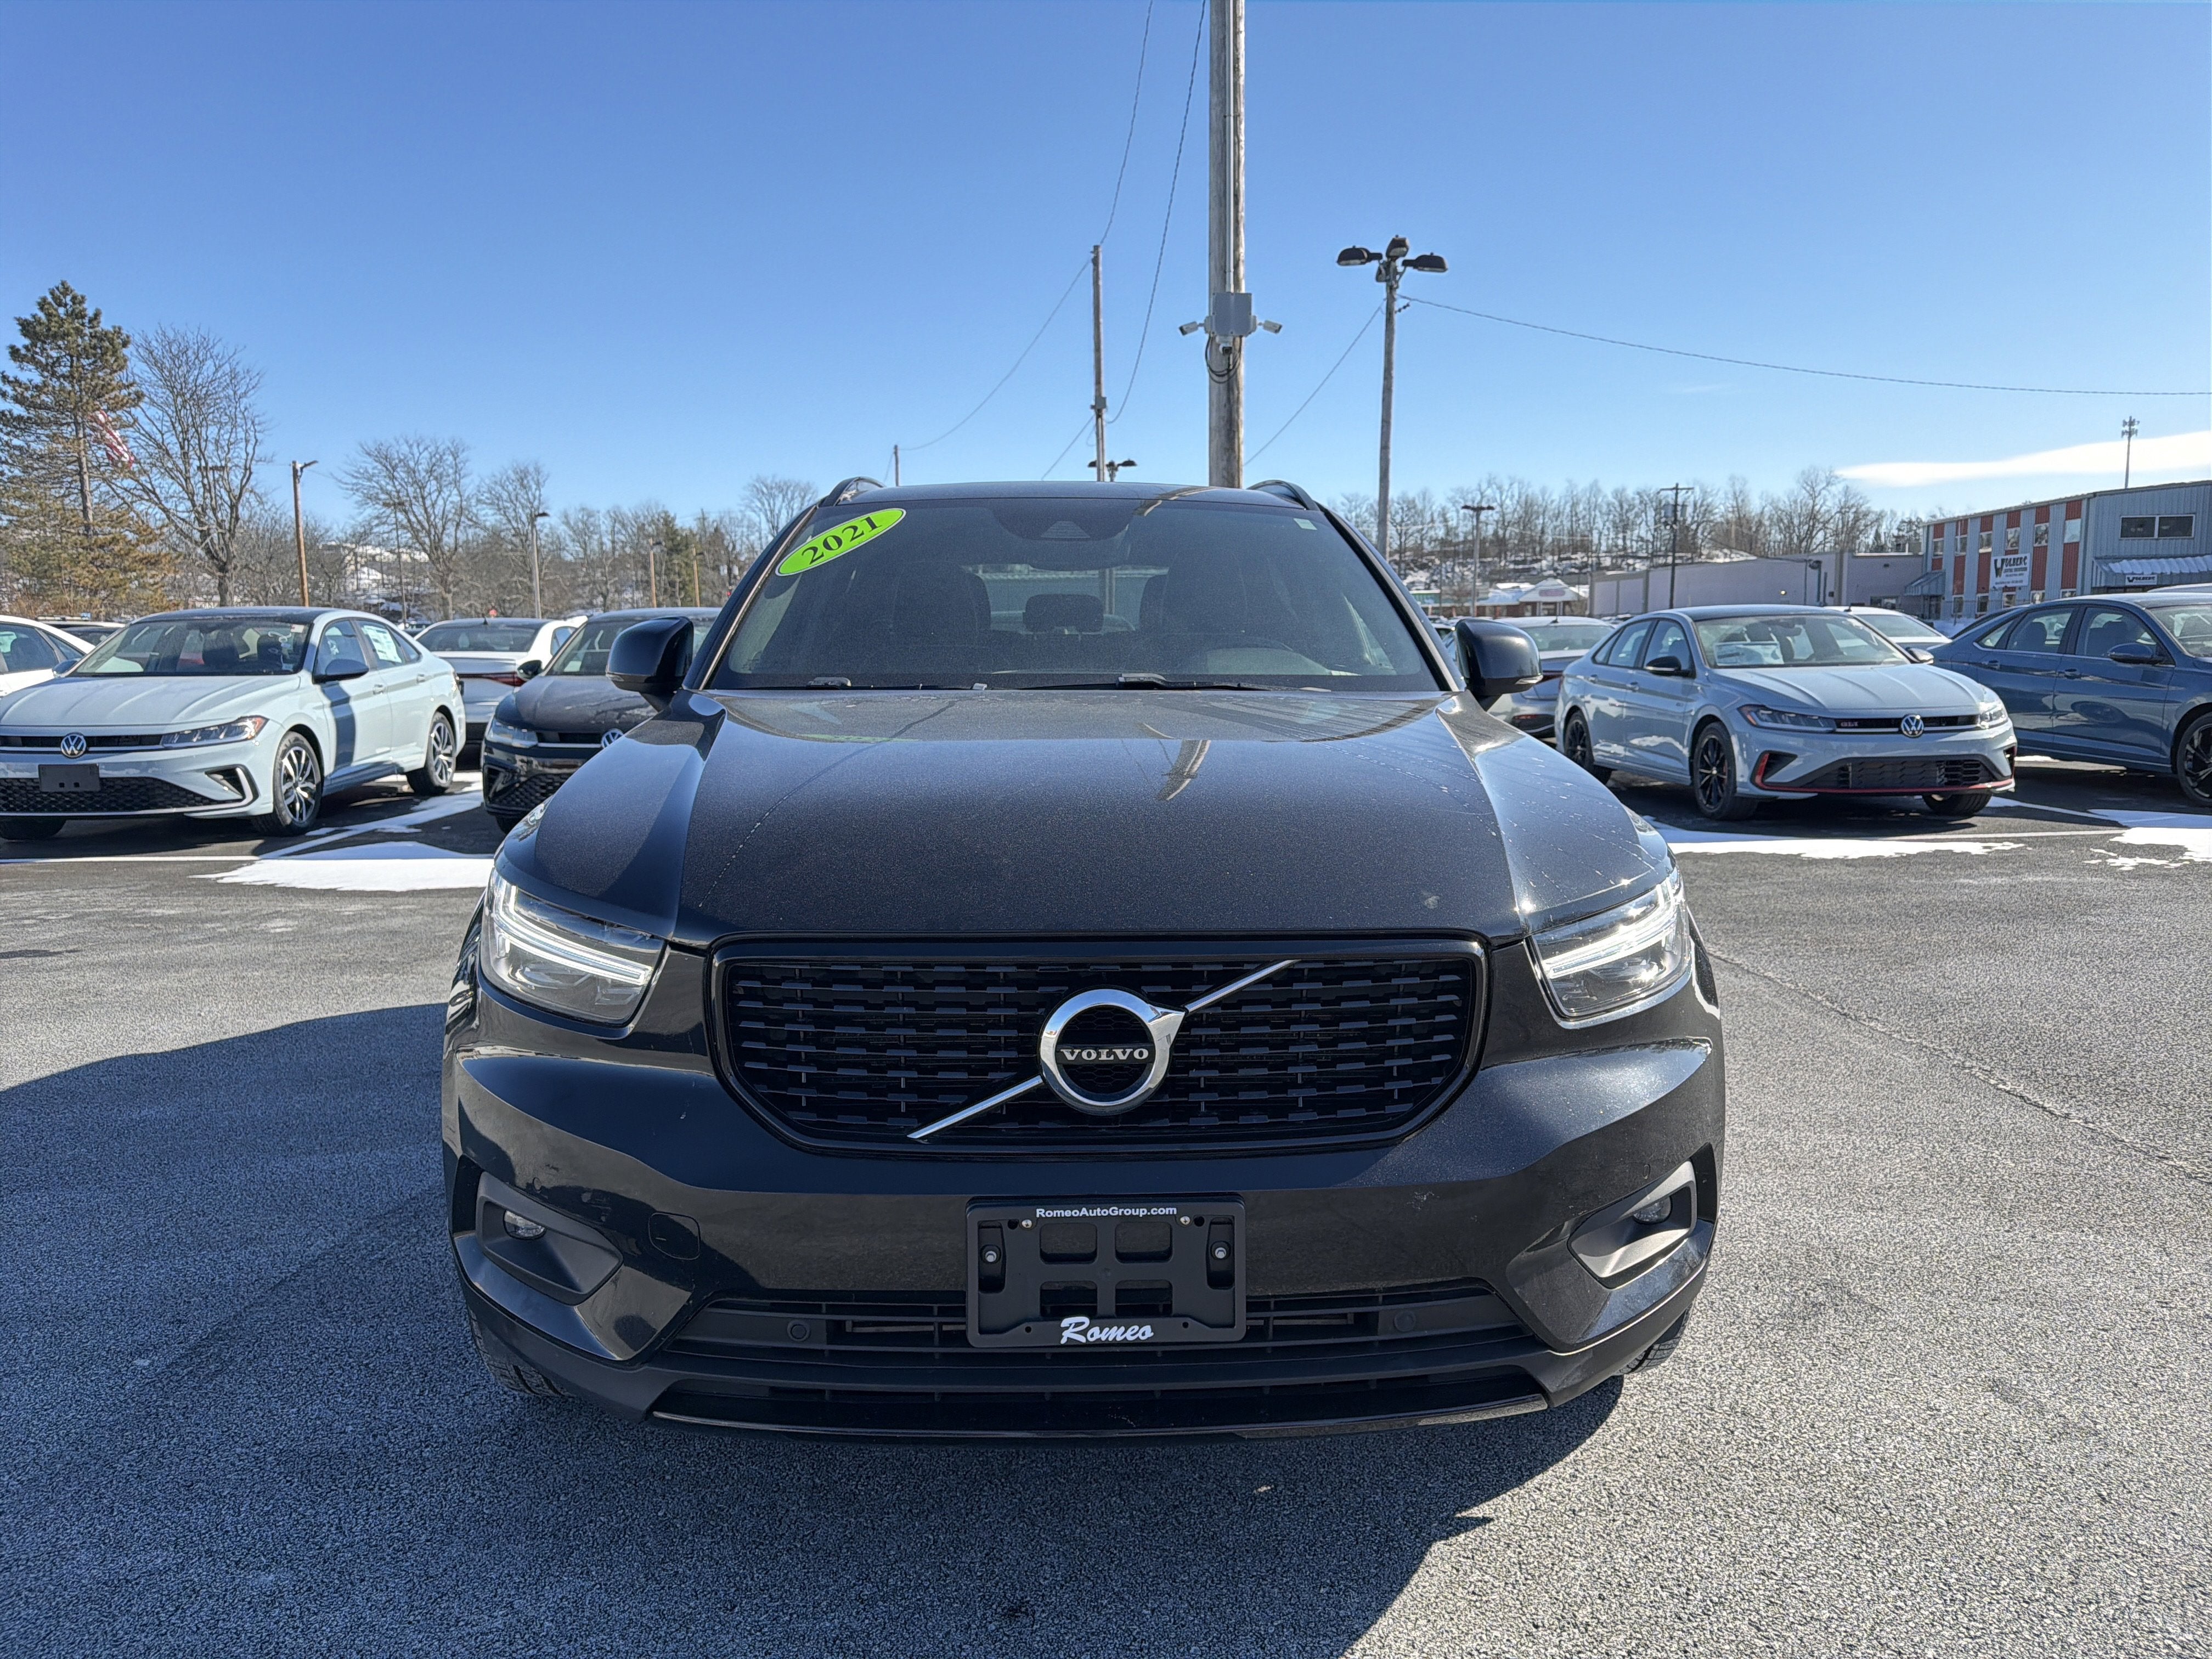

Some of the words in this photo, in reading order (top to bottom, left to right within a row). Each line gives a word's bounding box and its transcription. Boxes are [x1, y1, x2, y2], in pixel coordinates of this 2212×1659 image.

[802, 516, 882, 565] 2021
[1060, 1048, 1149, 1060] VOLVO
[1036, 1206, 1177, 1217] RomeoAutoGroup.com
[1060, 1316, 1154, 1345] Romeo
